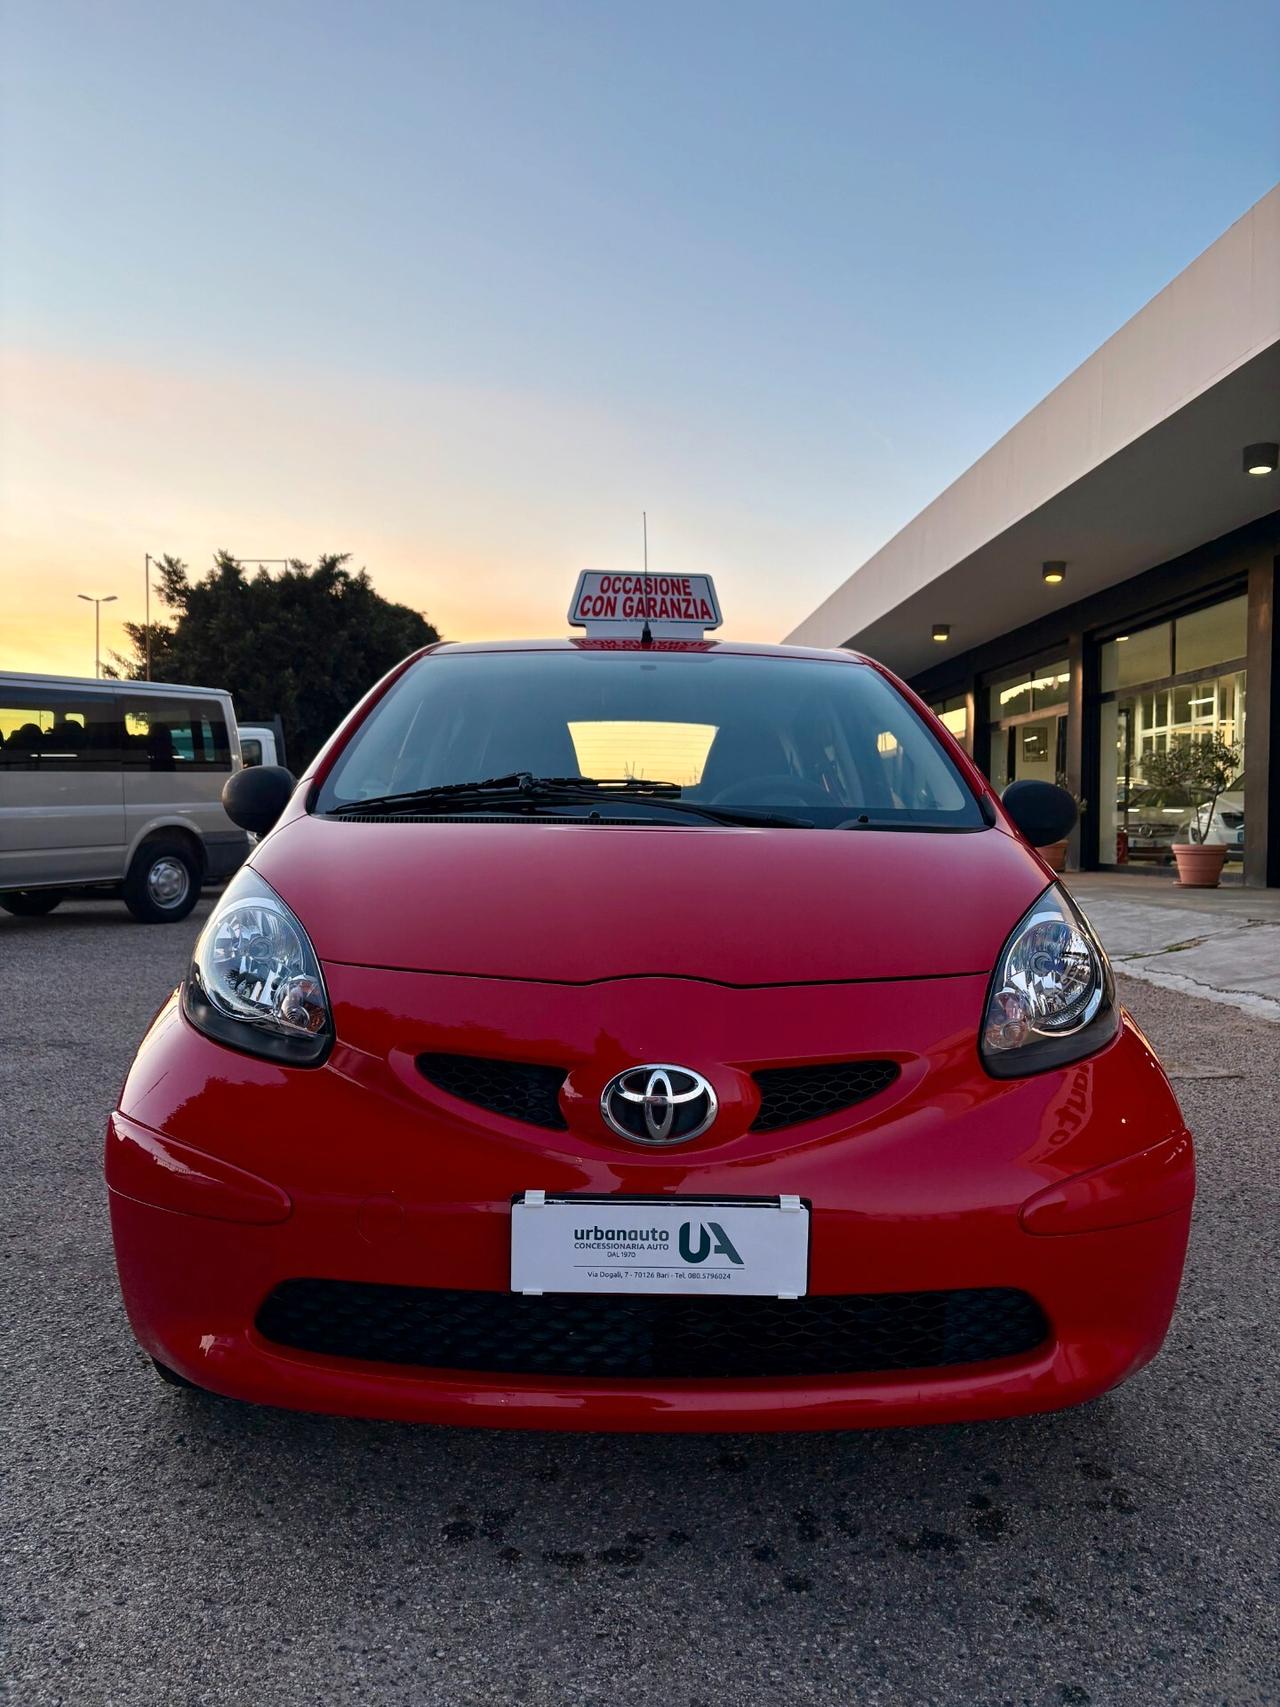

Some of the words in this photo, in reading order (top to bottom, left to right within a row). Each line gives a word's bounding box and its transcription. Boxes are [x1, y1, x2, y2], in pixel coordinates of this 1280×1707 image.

[600, 575, 693, 596] OCCASIONE
[580, 595, 618, 617] CON
[622, 597, 714, 620] GARANZIA
[574, 1226, 670, 1242] urbanauto
[574, 1242, 645, 1251] CONCESSIONARIA
[646, 1243, 670, 1251] AUTO
[679, 1222, 744, 1265] UA
[600, 1271, 623, 1279] Dogali,
[634, 1271, 655, 1279] 70126
[656, 1271, 669, 1279] Bari
